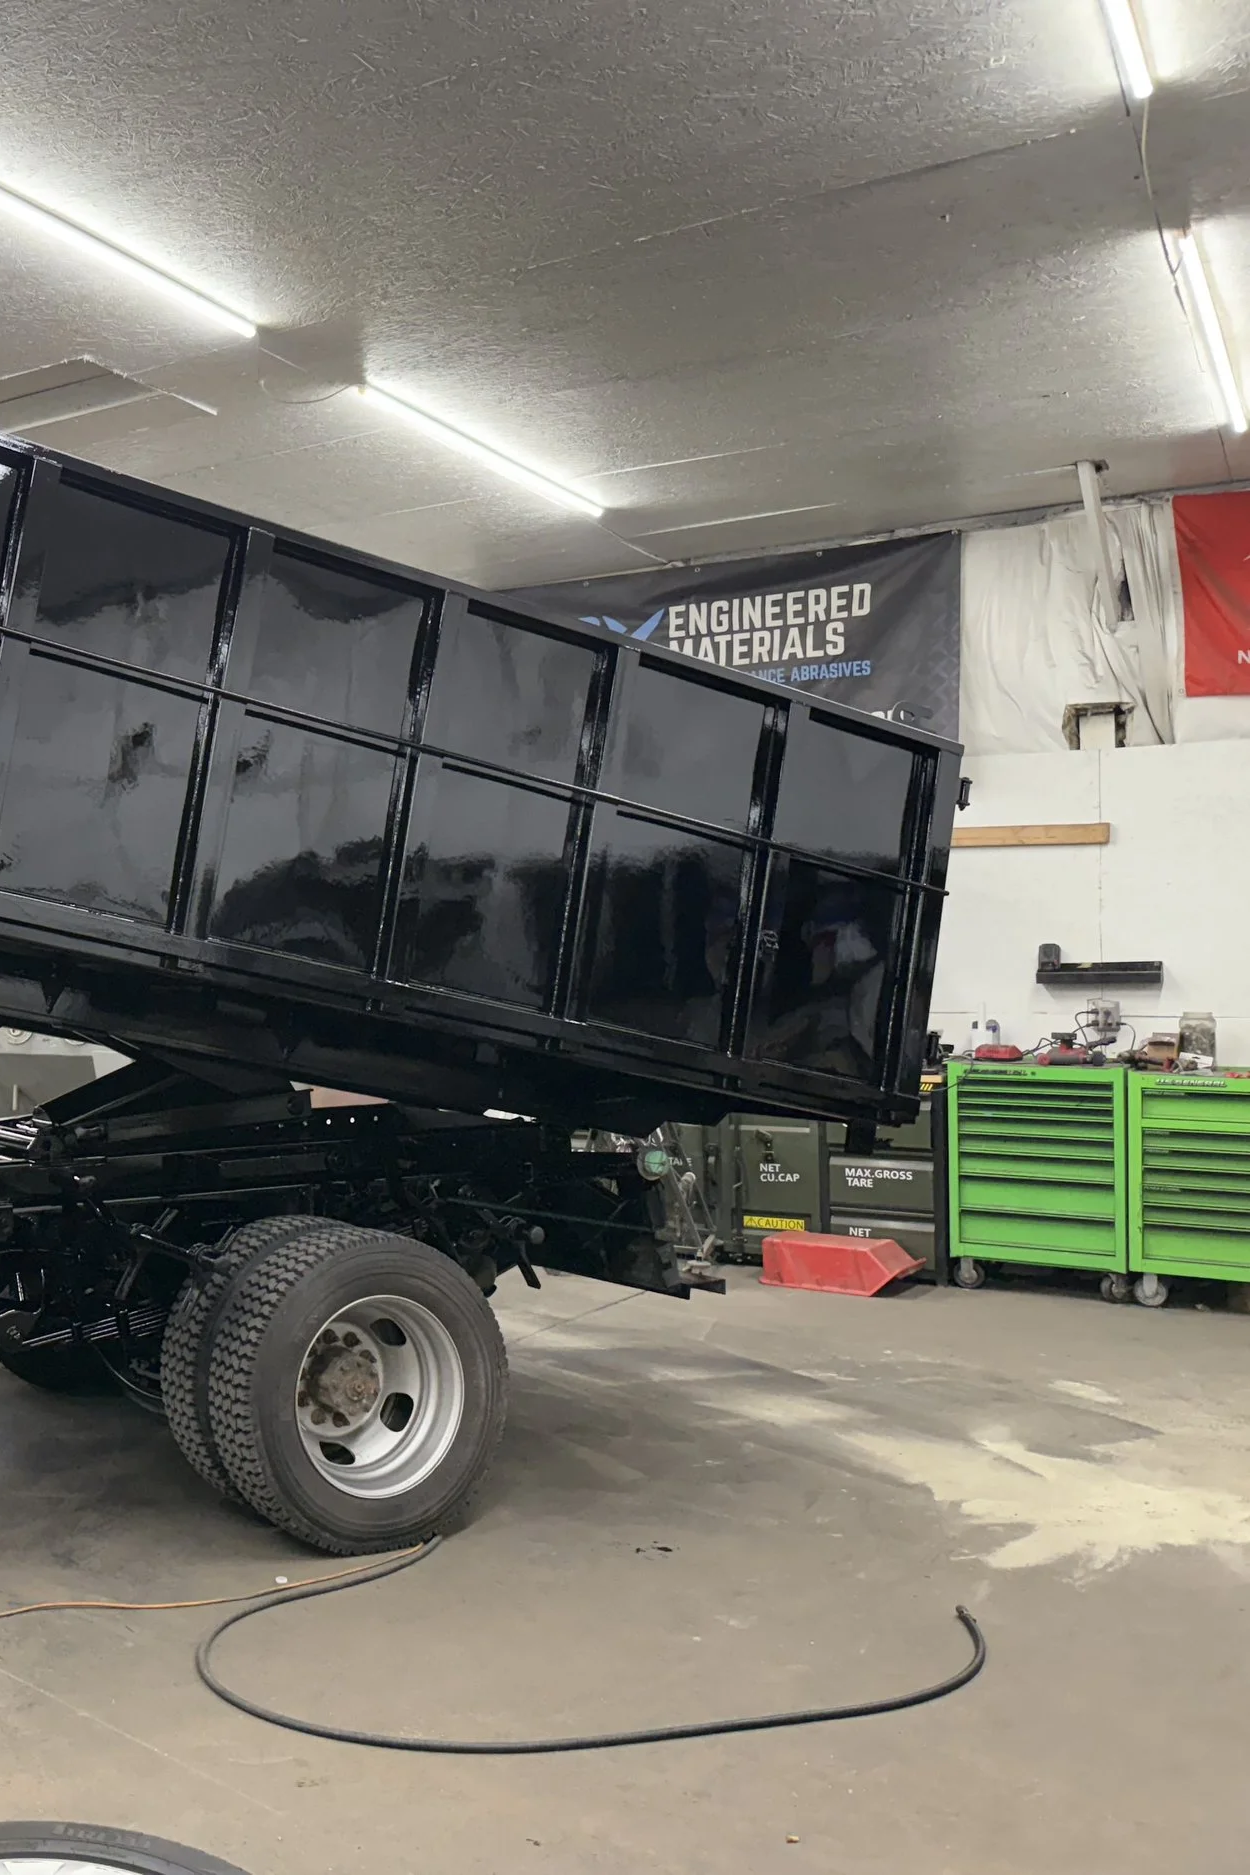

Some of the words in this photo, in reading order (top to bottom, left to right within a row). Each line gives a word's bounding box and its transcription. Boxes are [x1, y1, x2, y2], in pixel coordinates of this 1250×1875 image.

[668, 582, 872, 638] ENGINEERED
[790, 659, 872, 683] ABRASIVES
[759, 1163, 781, 1173] NET
[760, 1173, 800, 1183] CU.CAP
[845, 1167, 913, 1181] MAX.GROSS
[846, 1178, 873, 1188] TARE
[757, 1218, 804, 1230] CAUTION
[849, 1227, 871, 1238] NET
